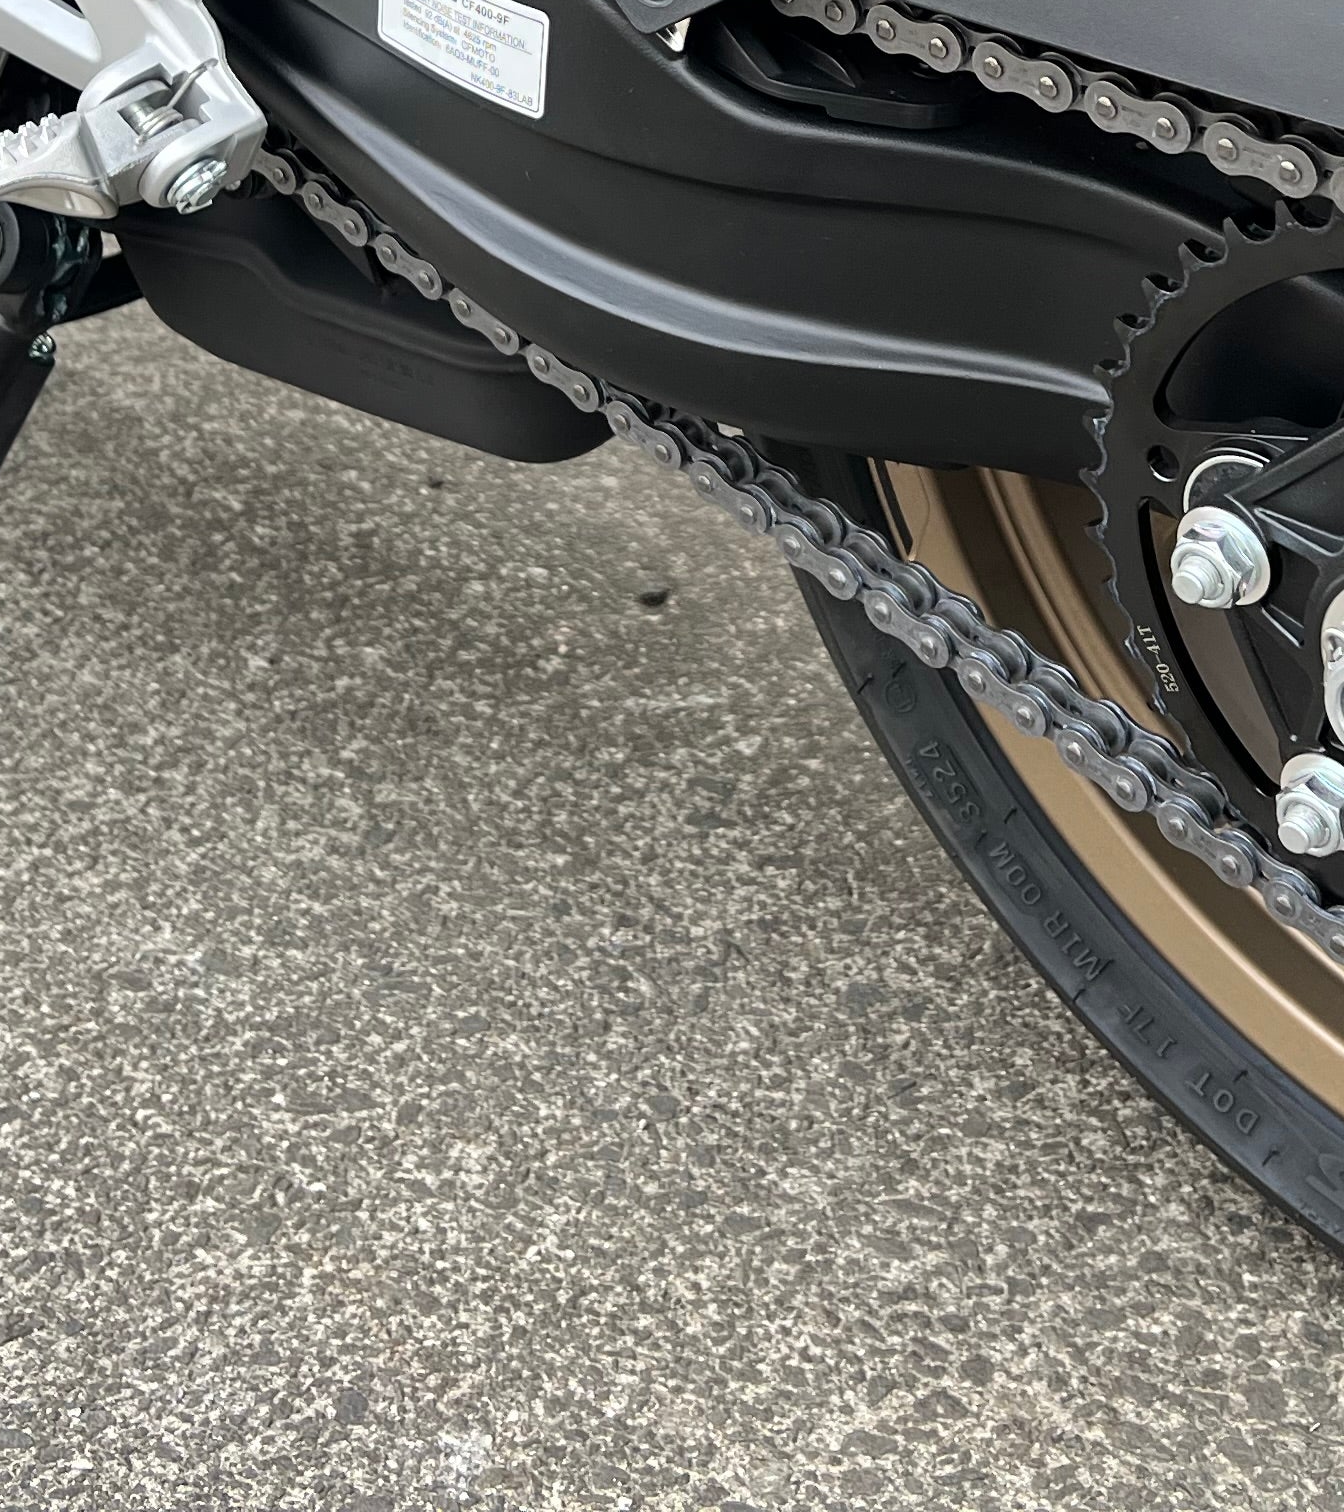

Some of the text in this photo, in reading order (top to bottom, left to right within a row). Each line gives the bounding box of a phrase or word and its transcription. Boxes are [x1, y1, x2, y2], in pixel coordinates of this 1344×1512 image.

[454, 10, 473, 26] TEST
[462, 39, 496, 63] CFMOTO
[1136, 622, 1180, 694] 520-41T
[916, 738, 982, 824] 3524
[1184, 1071, 1261, 1137] DOT
